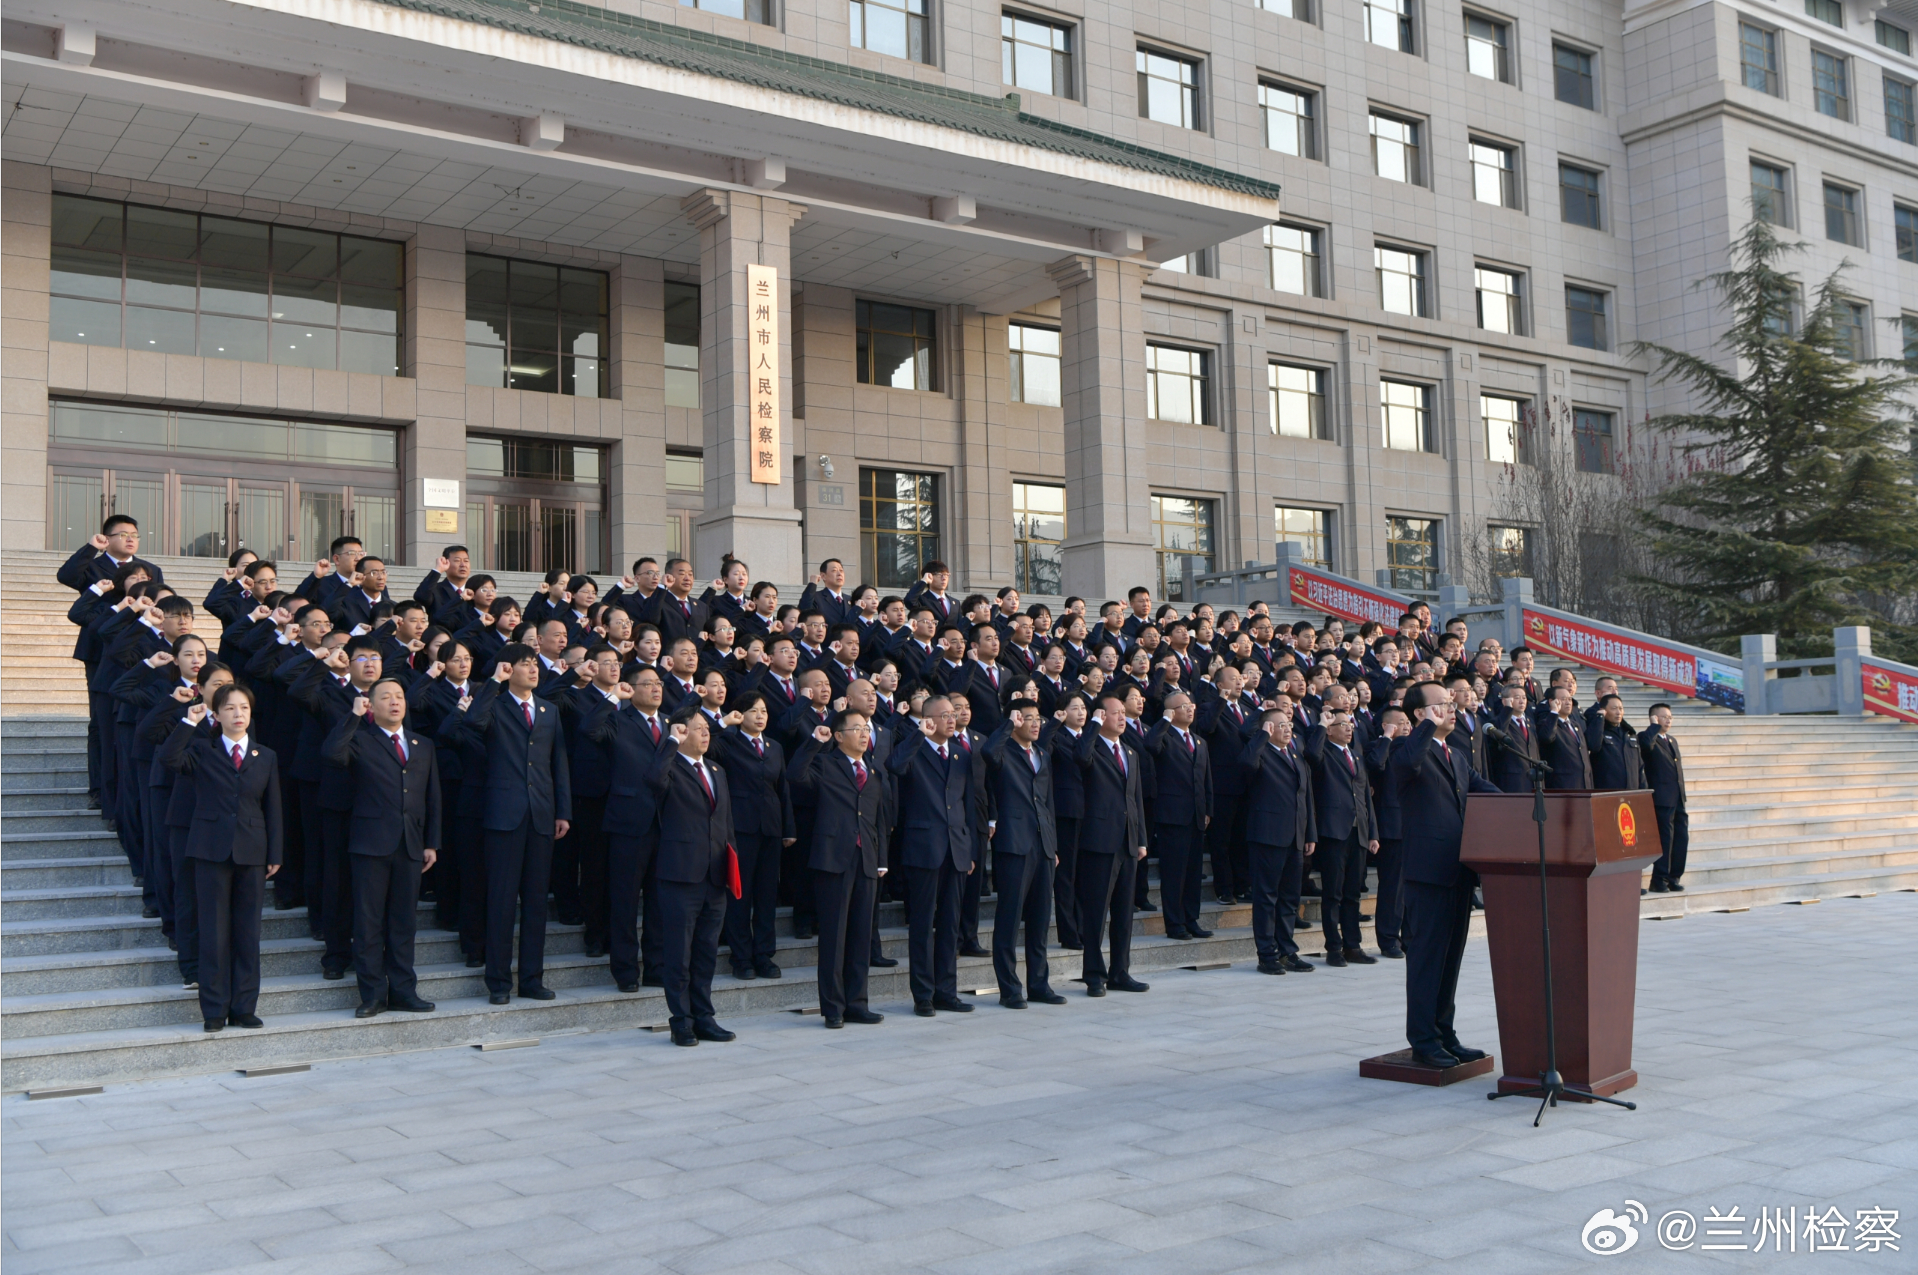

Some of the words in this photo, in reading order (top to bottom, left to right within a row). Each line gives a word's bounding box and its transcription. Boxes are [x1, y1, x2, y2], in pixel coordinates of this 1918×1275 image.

[755, 280, 774, 469] 兰州市人民检察院
[1548, 622, 1693, 687] 以新气象新作为推动高质量发展取得新成效
